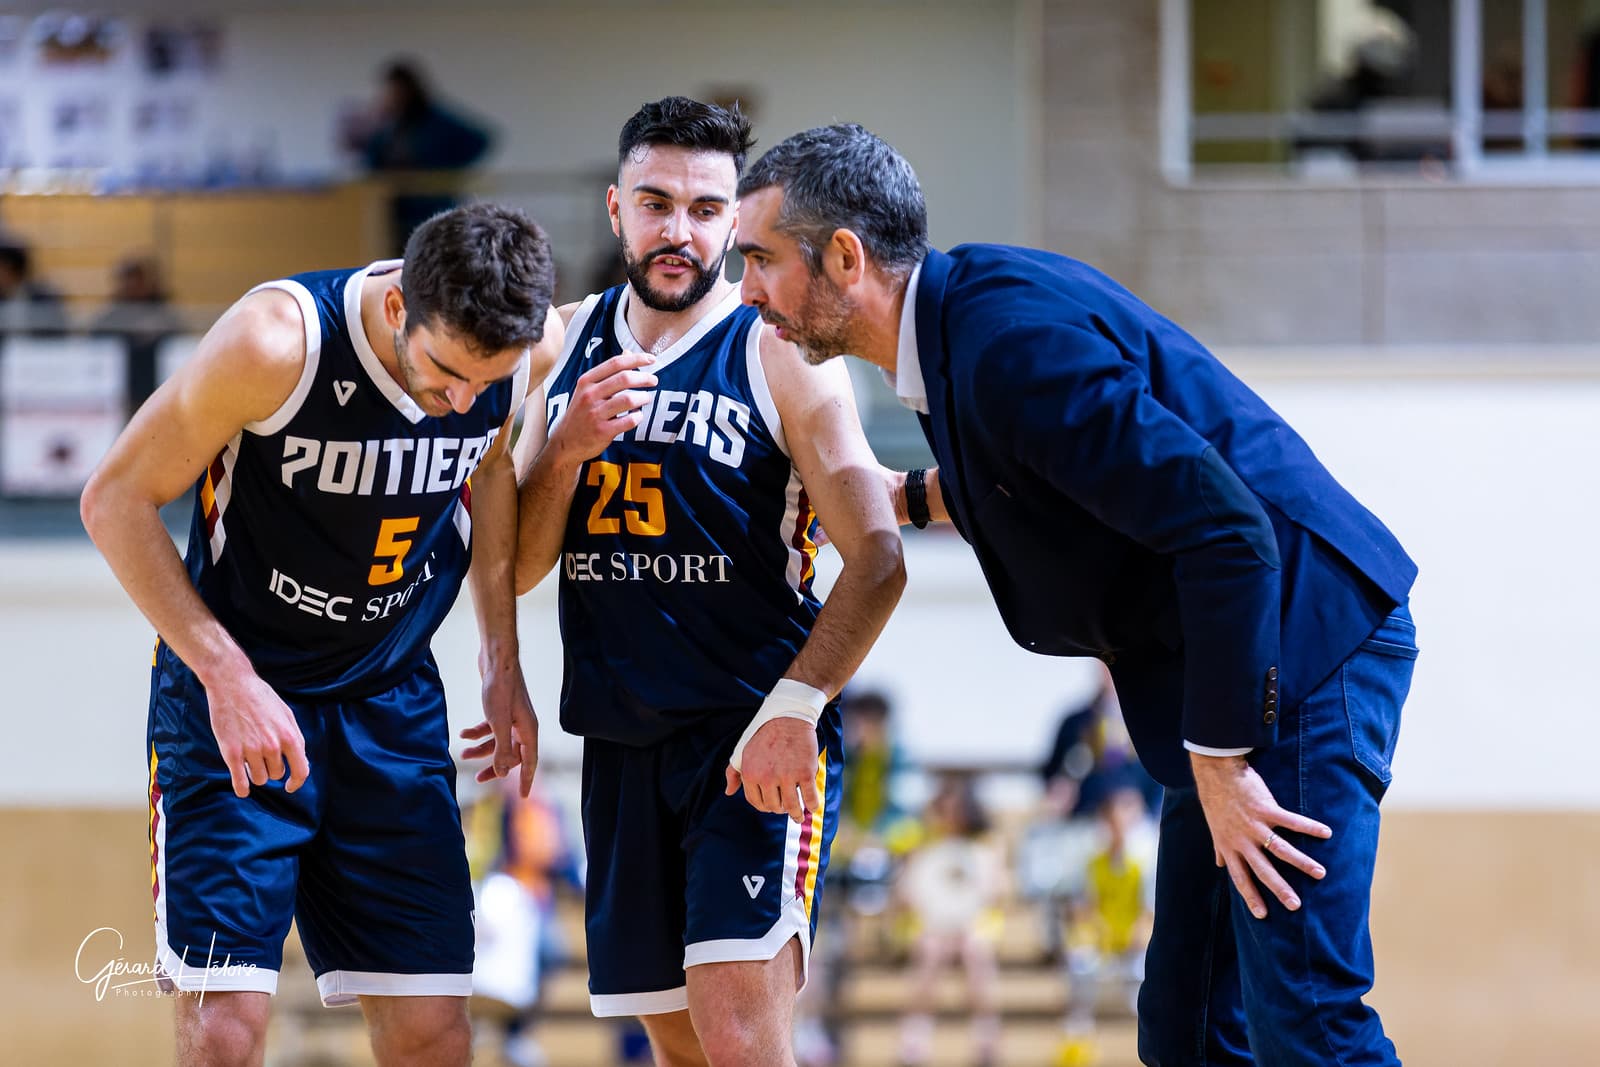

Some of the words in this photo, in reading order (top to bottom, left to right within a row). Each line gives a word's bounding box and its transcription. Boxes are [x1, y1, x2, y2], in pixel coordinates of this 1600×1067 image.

[547, 389, 750, 469] PIERS
[586, 461, 666, 536] 25
[367, 516, 420, 586] 5
[610, 551, 734, 583] SPORT
[269, 568, 353, 622] IDEC
